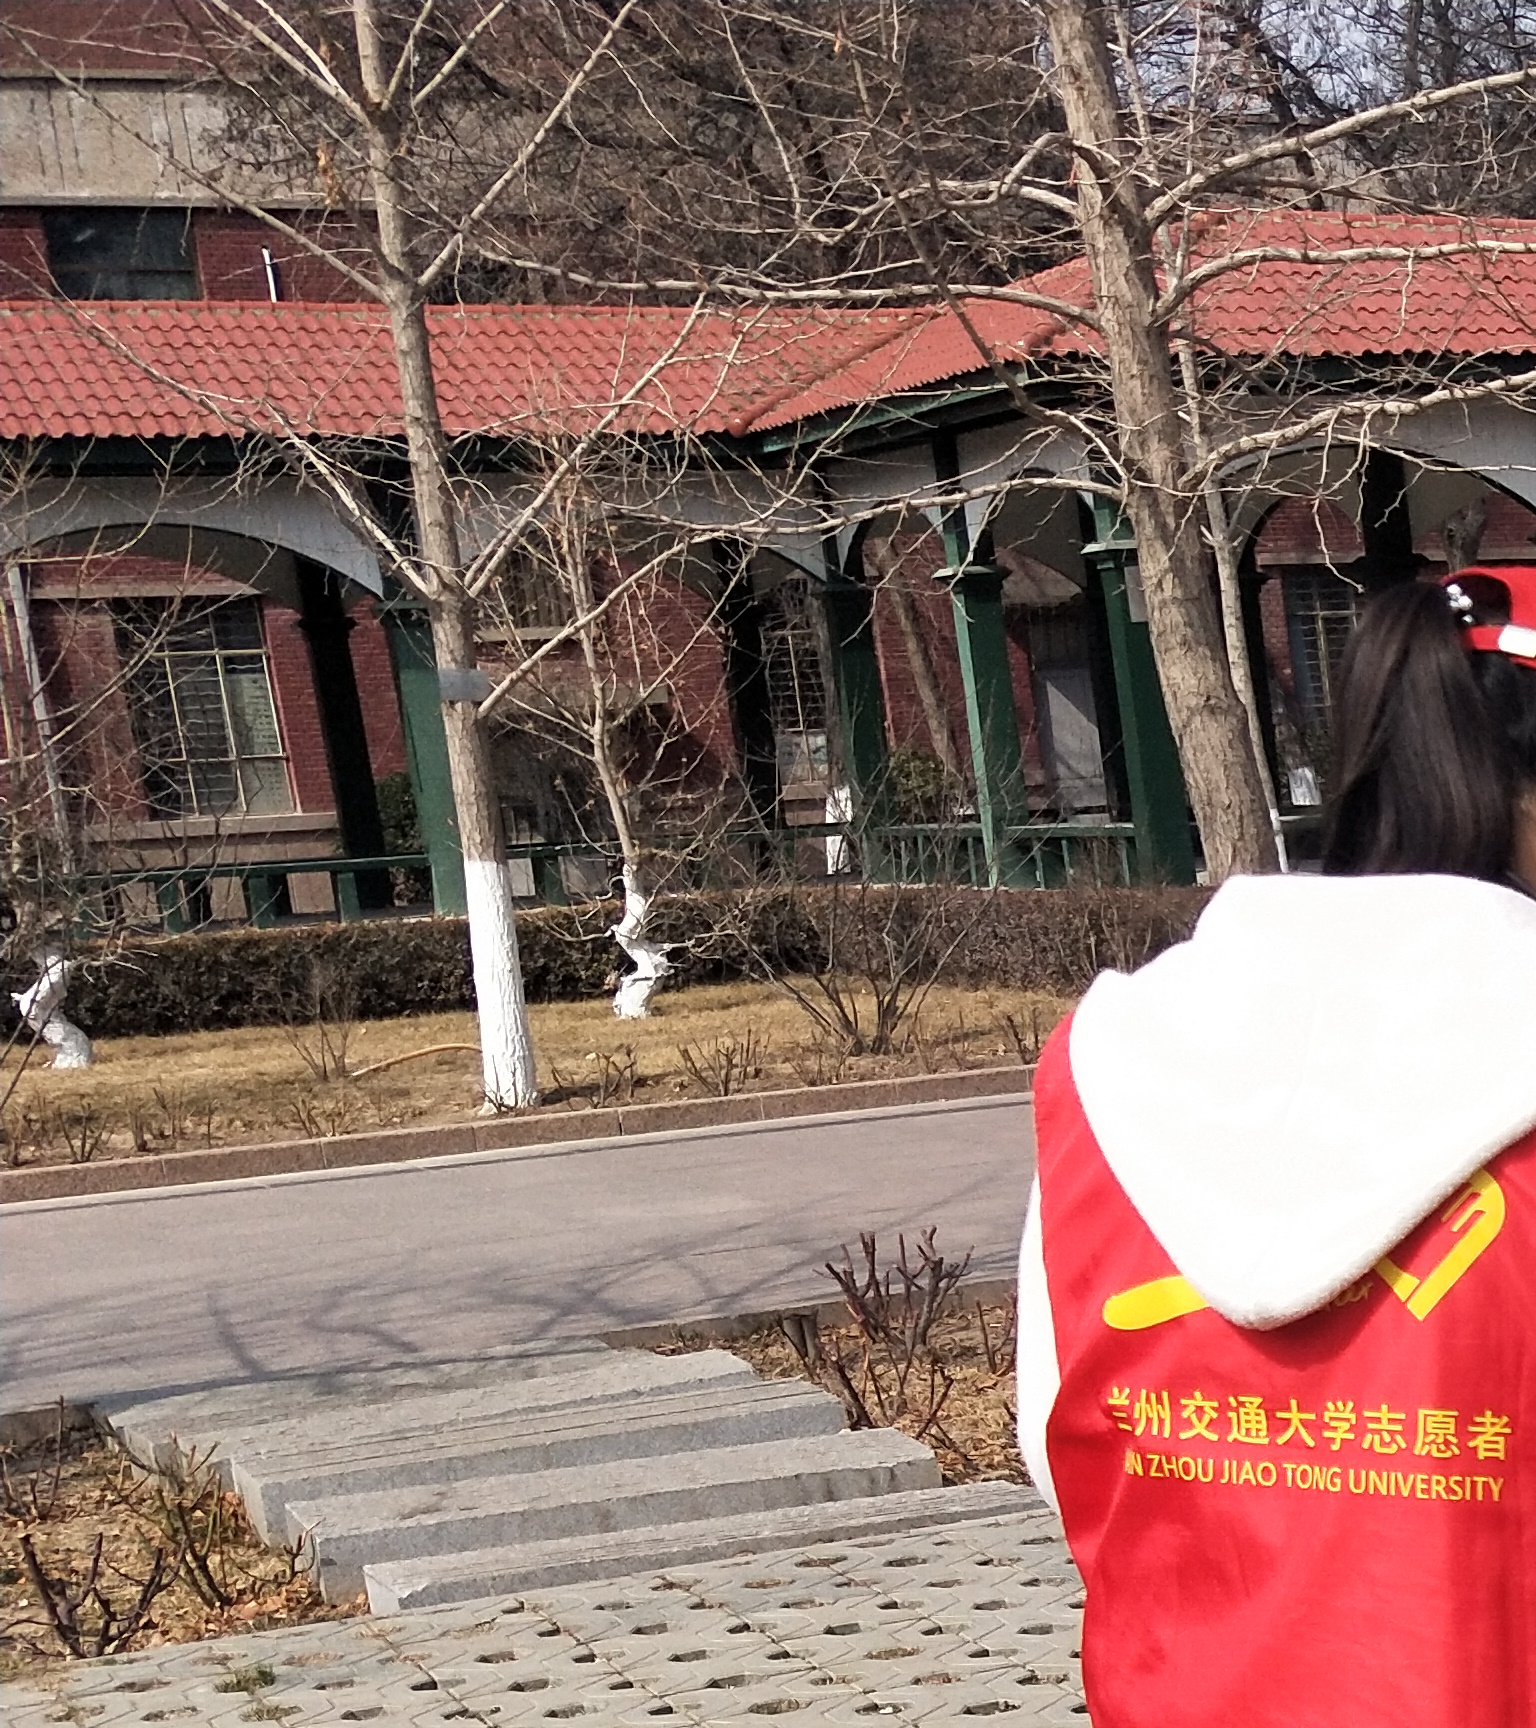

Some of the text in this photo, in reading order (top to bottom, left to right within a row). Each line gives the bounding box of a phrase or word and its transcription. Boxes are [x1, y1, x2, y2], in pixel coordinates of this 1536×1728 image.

[1108, 1387, 1512, 1460] 兰州交通大学志愿者
[1147, 1454, 1214, 1482] ZHOU
[1220, 1459, 1277, 1486] JIAO
[1283, 1463, 1341, 1492] TONG
[1349, 1468, 1504, 1501] UNIVERSITY
